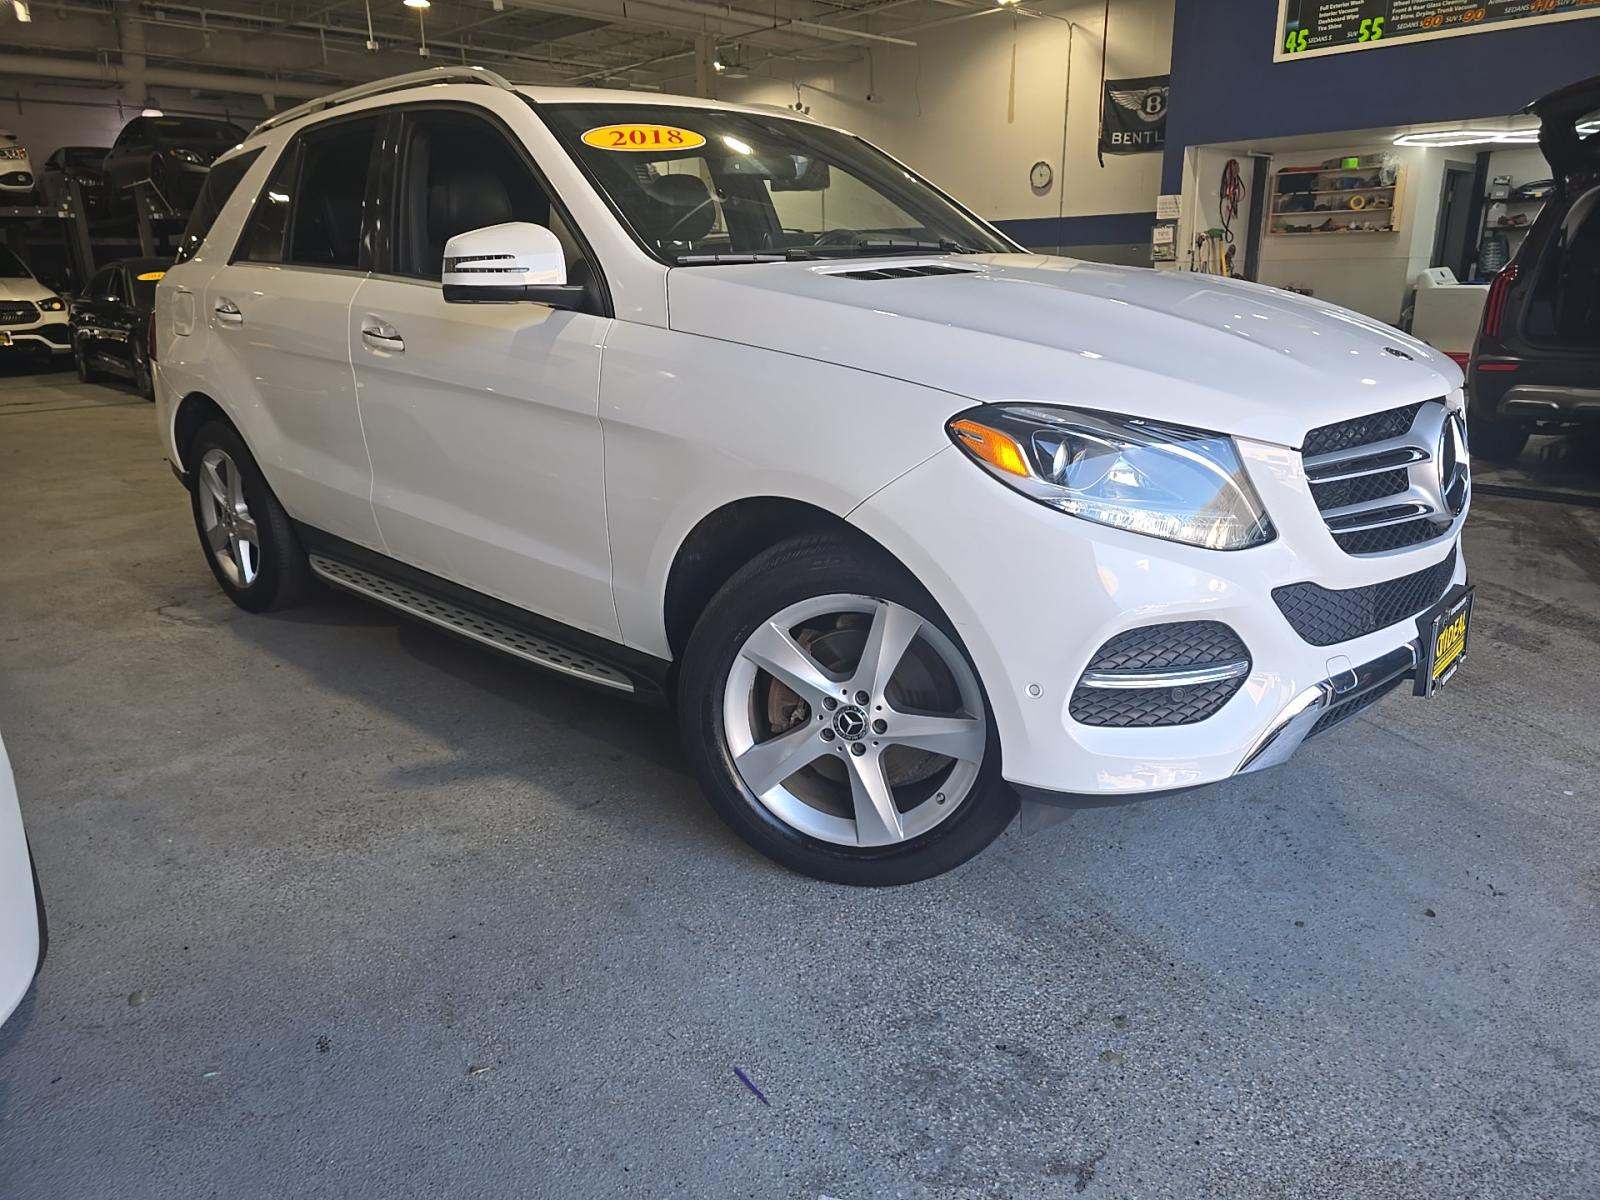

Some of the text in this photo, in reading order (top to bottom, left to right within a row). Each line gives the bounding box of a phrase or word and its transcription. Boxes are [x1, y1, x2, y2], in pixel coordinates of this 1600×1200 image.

[1286, 28, 1310, 52] 45
[1358, 16, 1384, 42] 55
[608, 130, 684, 146] 2018
